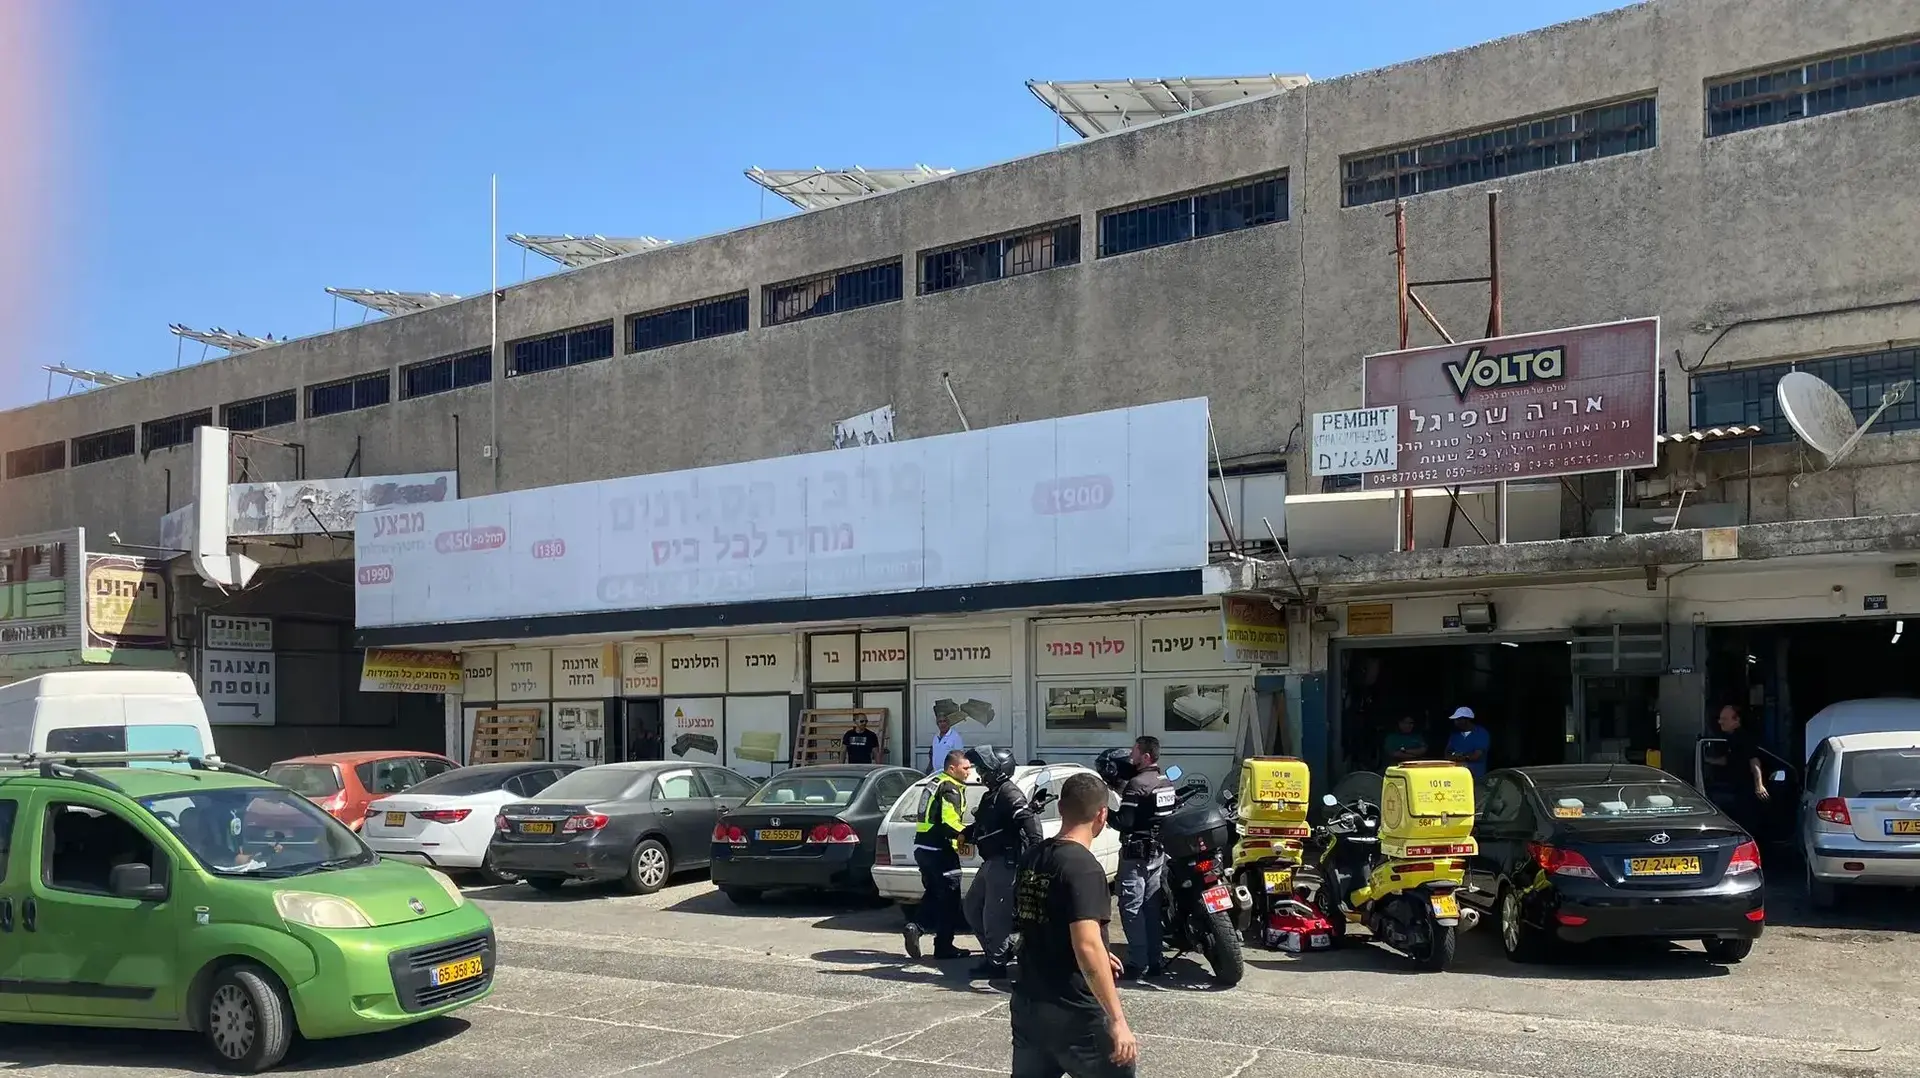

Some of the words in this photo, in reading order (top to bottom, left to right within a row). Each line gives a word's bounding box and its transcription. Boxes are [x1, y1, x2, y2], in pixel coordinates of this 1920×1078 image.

[1526, 395, 1604, 422] אריה
[1322, 409, 1389, 431] РЕМОНТ
[1408, 405, 1508, 433] שפיגל
[1420, 453, 1459, 465] שעות
[1465, 449, 1488, 460] 24
[1373, 469, 1439, 485] 04-8770452
[373, 511, 425, 538] מבצע
[713, 519, 769, 564] לכל
[96, 579, 158, 600] ריהוט
[211, 619, 270, 632] ריהוט
[1046, 640, 1084, 658] פנתי
[1088, 635, 1125, 658] סלון
[1152, 634, 1194, 653] שינה
[745, 653, 777, 668] מרכז
[823, 651, 840, 664] בר
[862, 648, 906, 663] כסאות
[933, 646, 991, 661] מזרונים
[209, 659, 271, 674] תצוגה
[511, 661, 534, 673] חדרי
[562, 657, 599, 670] ארונות
[671, 654, 720, 670] הסלונים
[209, 680, 270, 695] נוספת
[511, 681, 537, 693] ילדים
[569, 674, 595, 686] הזזה
[625, 677, 659, 689] כניסה
[1429, 780, 1442, 788] 101
[1259, 790, 1300, 799] פראמדיק
